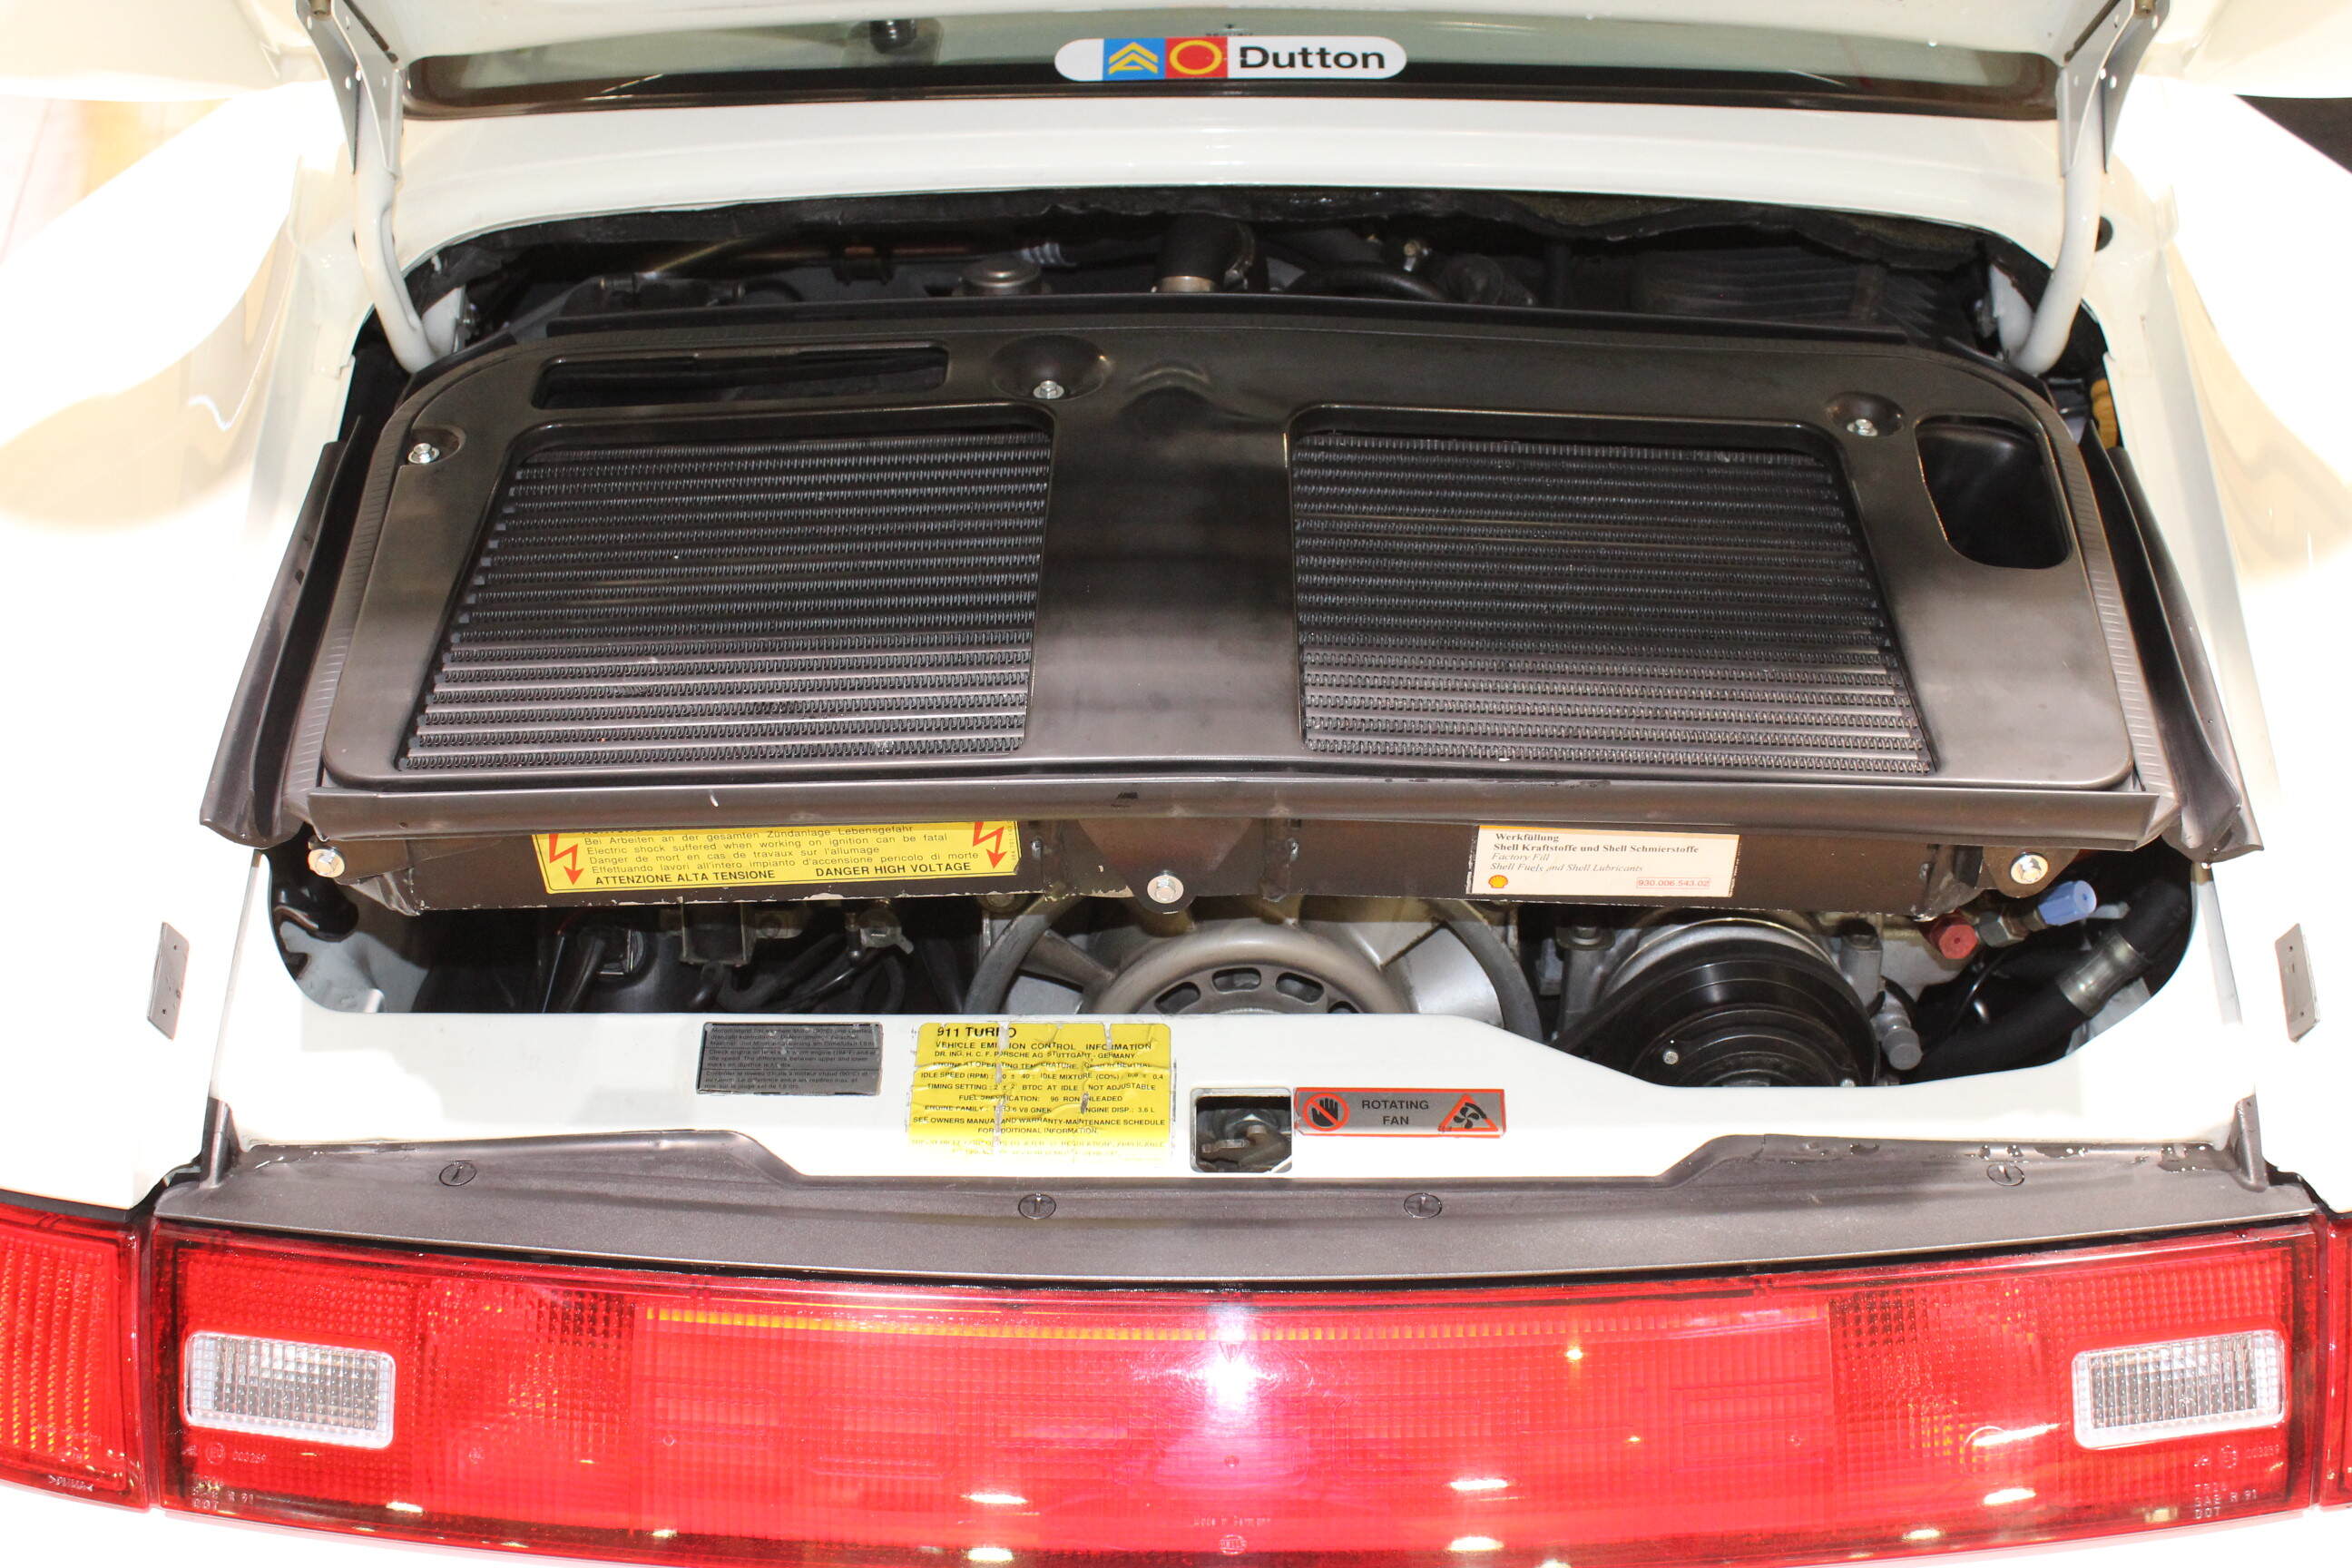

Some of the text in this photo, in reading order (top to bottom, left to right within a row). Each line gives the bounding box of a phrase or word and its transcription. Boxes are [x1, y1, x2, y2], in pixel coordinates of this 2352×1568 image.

[1240, 46, 1386, 69] Dutton
[584, 838, 602, 846] Bei
[610, 836, 654, 844] Arbeiten
[707, 832, 760, 842] gesamten
[768, 828, 831, 838] Zündanlage
[838, 825, 913, 835] Lebensgefahr
[1495, 833, 1560, 842] Werkfüllung
[587, 847, 627, 855] Electric
[634, 844, 666, 853] shock
[672, 843, 717, 852] suffered
[724, 841, 752, 849] when
[760, 840, 801, 849] working
[829, 837, 868, 847] ignition
[876, 836, 896, 844] can
[924, 833, 947, 842] fatal
[1494, 843, 1699, 854] Shell Kraftstoffe und Shell Schmierstoffe
[589, 857, 628, 866] Danger
[707, 852, 726, 860] cas
[753, 850, 793, 858] travaux
[824, 847, 879, 855] l'allumage
[1491, 852, 1550, 862] Factory Fill
[592, 865, 653, 874] Effettuando
[661, 863, 690, 871] lavori
[750, 859, 796, 868] impianto
[802, 857, 873, 866] d'accensione
[880, 854, 924, 863] pericolo
[931, 852, 940, 860] di
[1490, 862, 1515, 871] Shell
[1517, 863, 1544, 872] Fuels
[1566, 863, 1591, 872] Shell
[1592, 864, 1643, 873] Lubricants
[815, 862, 972, 877] DANGER HIGH VOLTAGE
[595, 869, 776, 886] ATTENZIONE ALTA TENSIONE
[937, 1026, 1016, 1038] 911 TURO
[936, 1041, 975, 1049] VEHICLE
[980, 1042, 1025, 1050] EMIION
[1030, 1042, 1075, 1051] CONTROL
[1046, 1050, 1091, 1058] STUTTGART
[1059, 1072, 1093, 1080] MIXTURE
[1106, 1083, 1156, 1091] ADJUSTABLE
[1361, 1100, 1430, 1110] ROTATING
[1382, 1115, 1410, 1125] FAN
